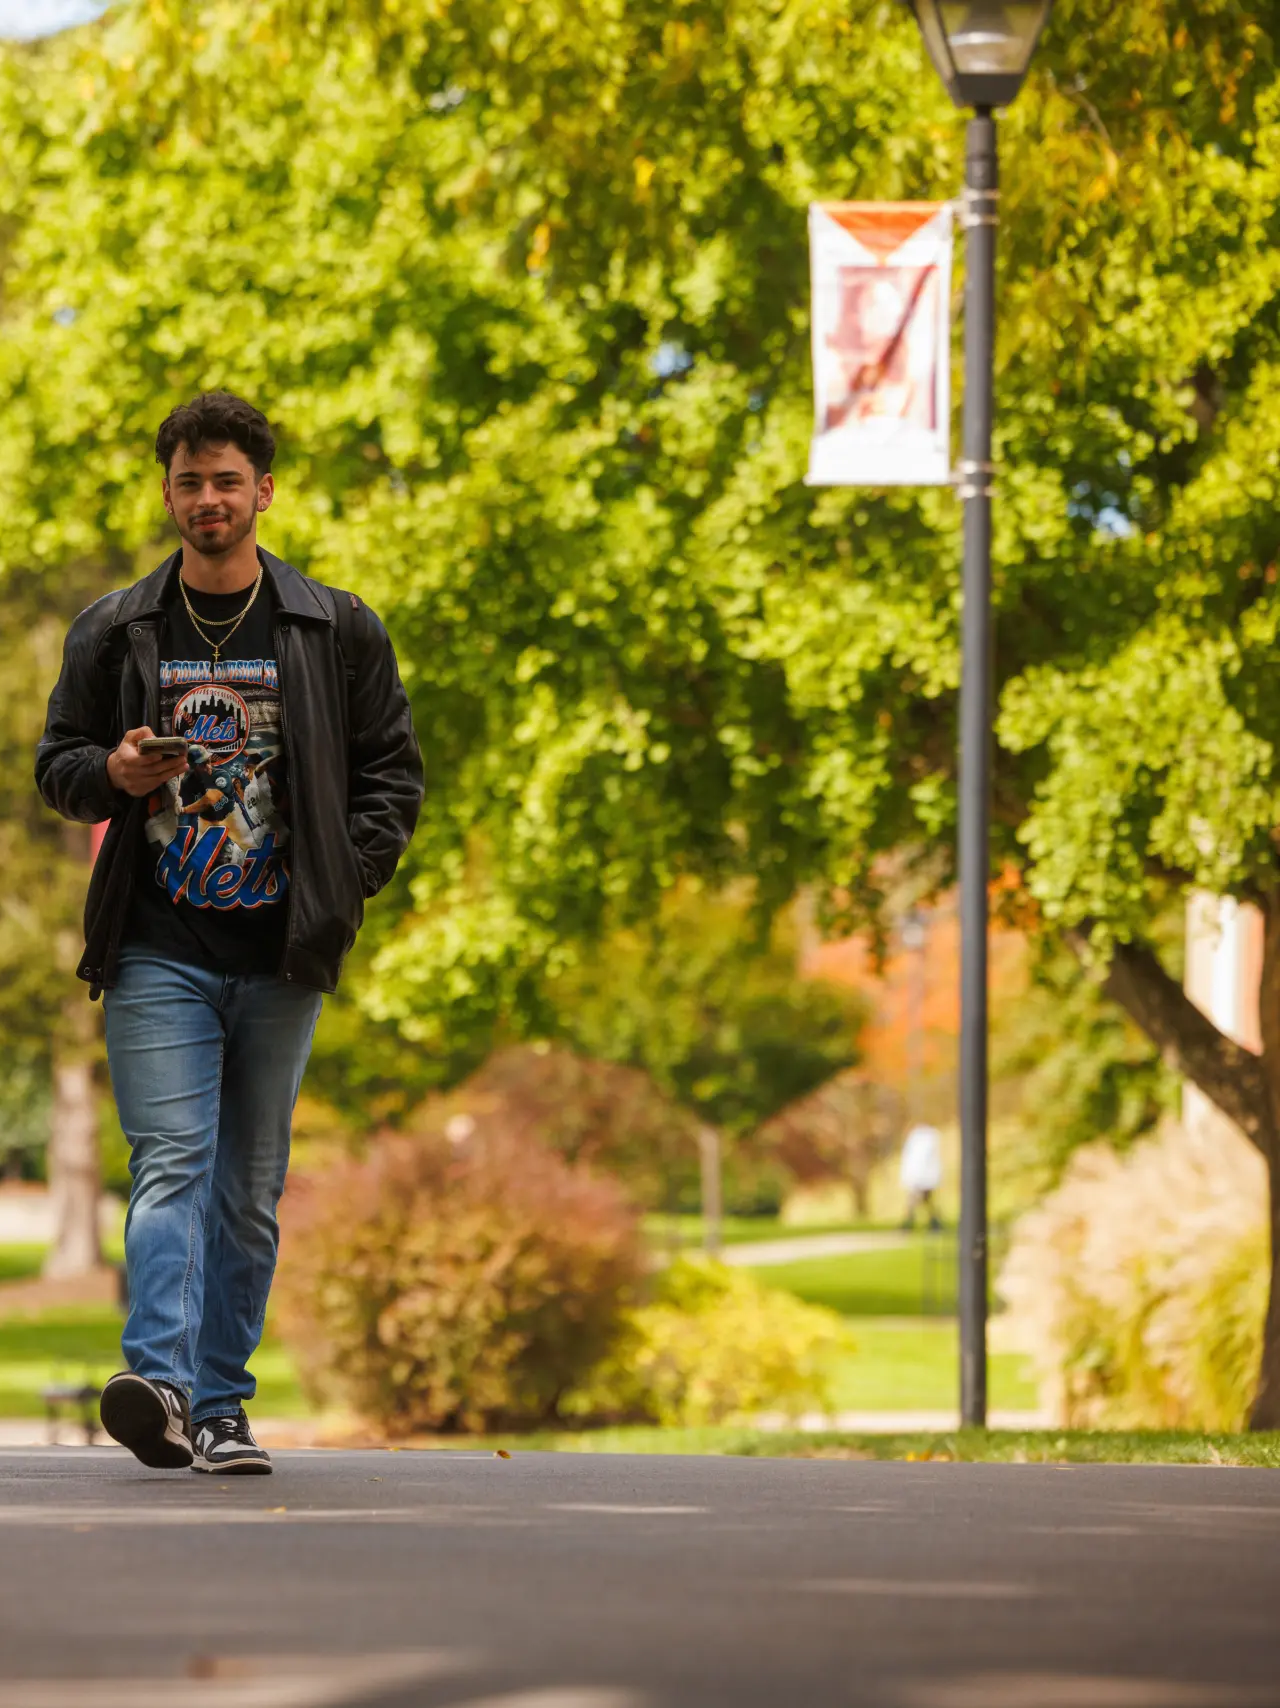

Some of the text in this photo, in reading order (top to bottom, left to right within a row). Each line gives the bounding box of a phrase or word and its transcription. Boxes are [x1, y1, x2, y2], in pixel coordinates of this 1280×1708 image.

[213, 659, 264, 684] DIVISION
[184, 715, 238, 742] Mets
[155, 825, 290, 911] Mets
